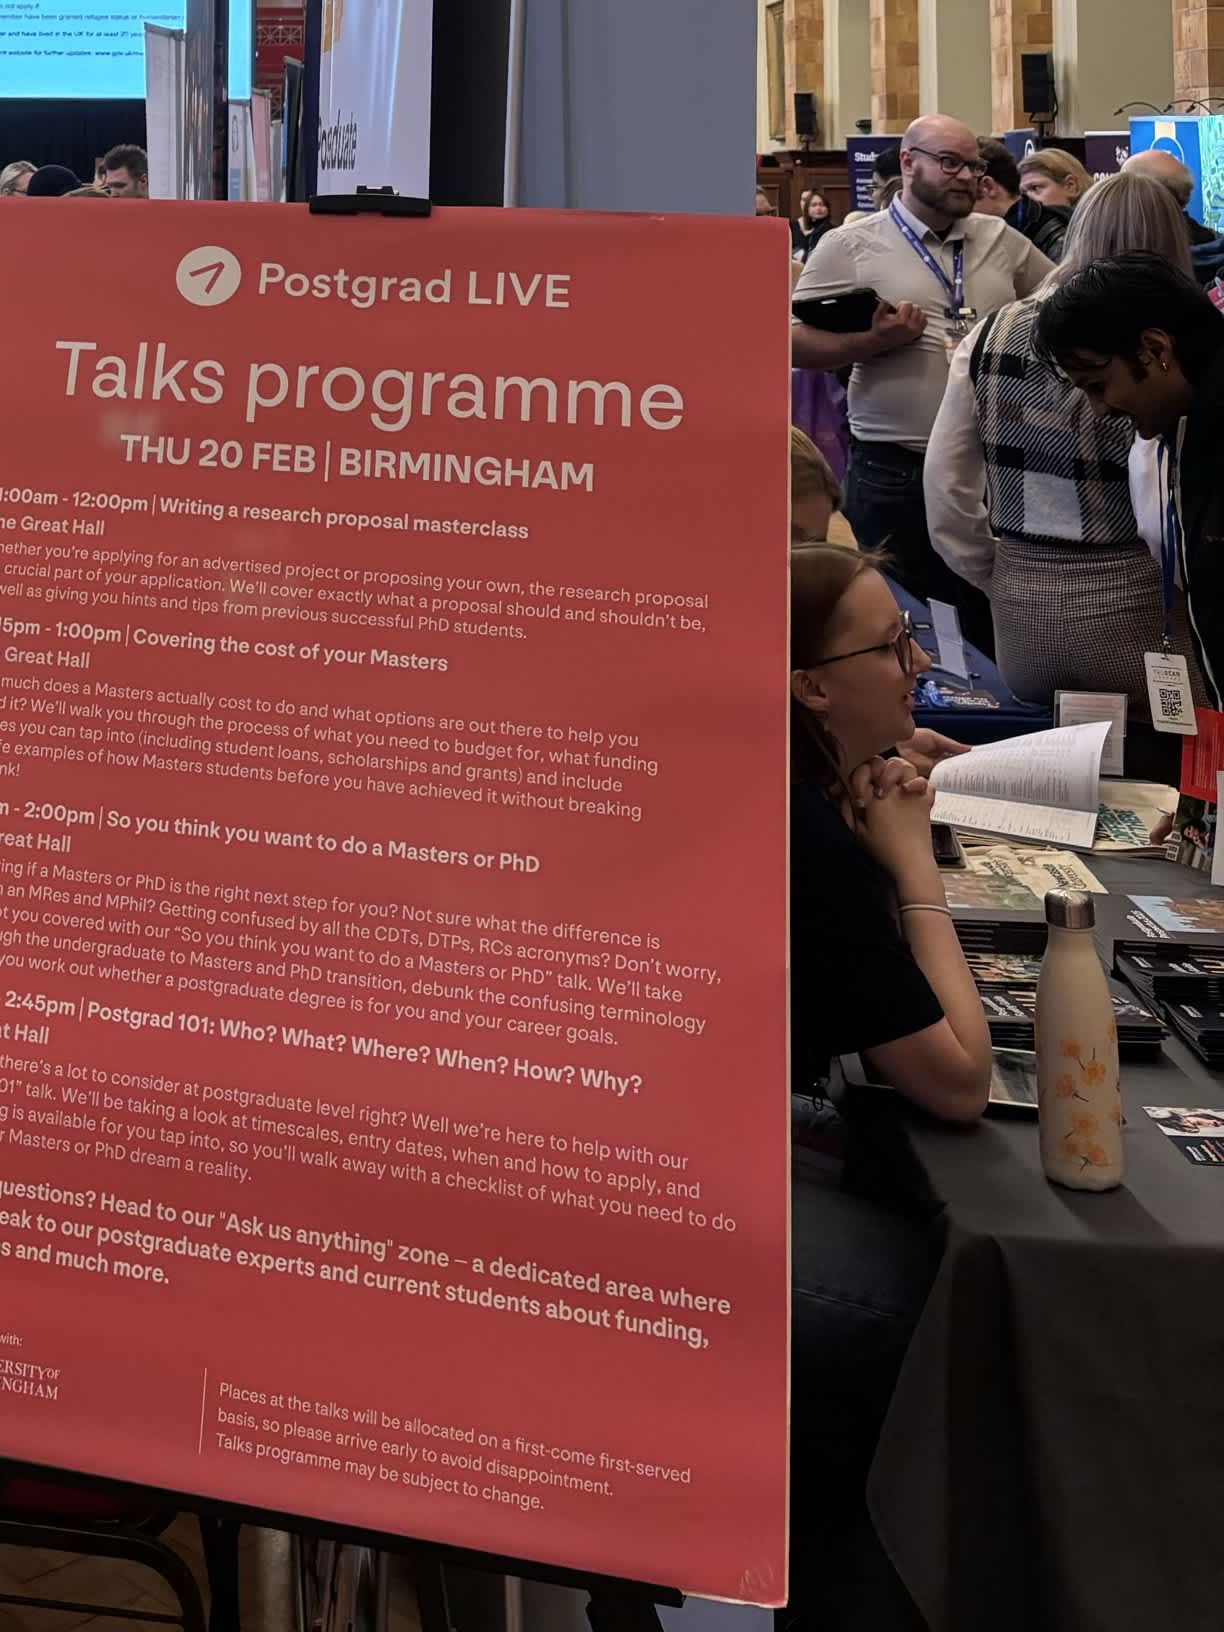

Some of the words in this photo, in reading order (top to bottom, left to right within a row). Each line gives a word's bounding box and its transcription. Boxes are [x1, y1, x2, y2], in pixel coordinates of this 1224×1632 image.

[258, 261, 453, 310] Postgrad
[467, 270, 572, 309] LIVE
[54, 340, 226, 405] Talks
[245, 362, 685, 433] programme
[119, 431, 192, 466] THU
[197, 438, 244, 470] 20
[251, 441, 317, 474] FEB
[338, 447, 595, 493] BIRMINGHAM
[19, 514, 70, 535] Great
[71, 518, 106, 537] Hall
[71, 490, 149, 515] 12:00pm
[159, 496, 226, 522] Writing
[227, 504, 240, 519] a
[242, 505, 323, 525] research
[325, 511, 410, 533] proposal
[412, 518, 530, 540] masterclass
[55, 621, 123, 646] 1:00pm
[132, 627, 217, 657] Covering
[219, 634, 251, 655] the
[253, 641, 297, 659] cost
[298, 642, 322, 661] of
[322, 647, 368, 667] your
[369, 648, 450, 673] Masters
[18, 721, 47, 738] you
[48, 724, 77, 739] can
[79, 725, 104, 745] tap
[106, 727, 136, 745] into
[137, 729, 213, 757] (including
[214, 740, 276, 759] student
[277, 744, 325, 766] loans,
[327, 751, 429, 777] scholarships
[431, 761, 463, 778] and
[465, 766, 524, 786] grants)
[526, 770, 559, 787] and
[561, 771, 623, 794] include
[23, 800, 96, 828] 2:00pm
[106, 809, 132, 830] So
[134, 816, 171, 836] you
[173, 817, 222, 840] think
[224, 826, 261, 846] you
[263, 830, 314, 850] want
[315, 833, 338, 853] to
[340, 834, 369, 856] do
[371, 842, 384, 858] a
[387, 839, 470, 867] Masters
[472, 853, 496, 870] or
[498, 851, 541, 874] PhD
[25, 930, 51, 948] the
[52, 936, 167, 963] undergraduate
[169, 949, 187, 966] to
[189, 950, 254, 974] Masters
[255, 961, 287, 978] and
[289, 962, 323, 982] PhD
[326, 968, 408, 996] transition,
[410, 978, 475, 1002] debunk
[477, 986, 507, 1006] the
[509, 993, 596, 1022] confusing
[599, 1003, 707, 1036] terminology
[3, 989, 77, 1019] 2:45pm
[86, 1000, 175, 1031] Postgrad
[177, 1012, 216, 1036] 101:
[219, 1017, 278, 1044] Who?
[280, 1025, 348, 1054] What?
[350, 1035, 432, 1065] Where?
[434, 1047, 510, 1076] When?
[513, 1057, 576, 1086] How?
[579, 1066, 643, 1098] Why?
[8, 1127, 72, 1153] Masters
[73, 1141, 92, 1157] or
[94, 1140, 127, 1161] PhD
[129, 1146, 182, 1170] dream
[184, 1158, 195, 1173] a
[197, 1160, 253, 1185] reality.
[14, 1243, 53, 1265] and
[55, 1249, 110, 1274] much
[112, 1260, 170, 1285] more.
[44, 1366, 62, 1383] OF
[219, 1381, 268, 1406] Places
[269, 1394, 285, 1410] at
[287, 1395, 312, 1414] the
[314, 1401, 351, 1422] talks
[352, 1408, 378, 1426] will
[380, 1411, 402, 1431] be
[403, 1417, 475, 1445] allocated
[477, 1433, 499, 1450] on
[501, 1438, 512, 1451] a
[514, 1436, 597, 1468] first-come
[598, 1451, 692, 1485] first-served
[215, 1432, 254, 1455] Talks
[255, 1443, 342, 1472] programme
[344, 1460, 377, 1482] may
[379, 1463, 400, 1483] be
[402, 1471, 460, 1495] subject
[462, 1481, 479, 1498] to
[481, 1484, 545, 1512] change.
